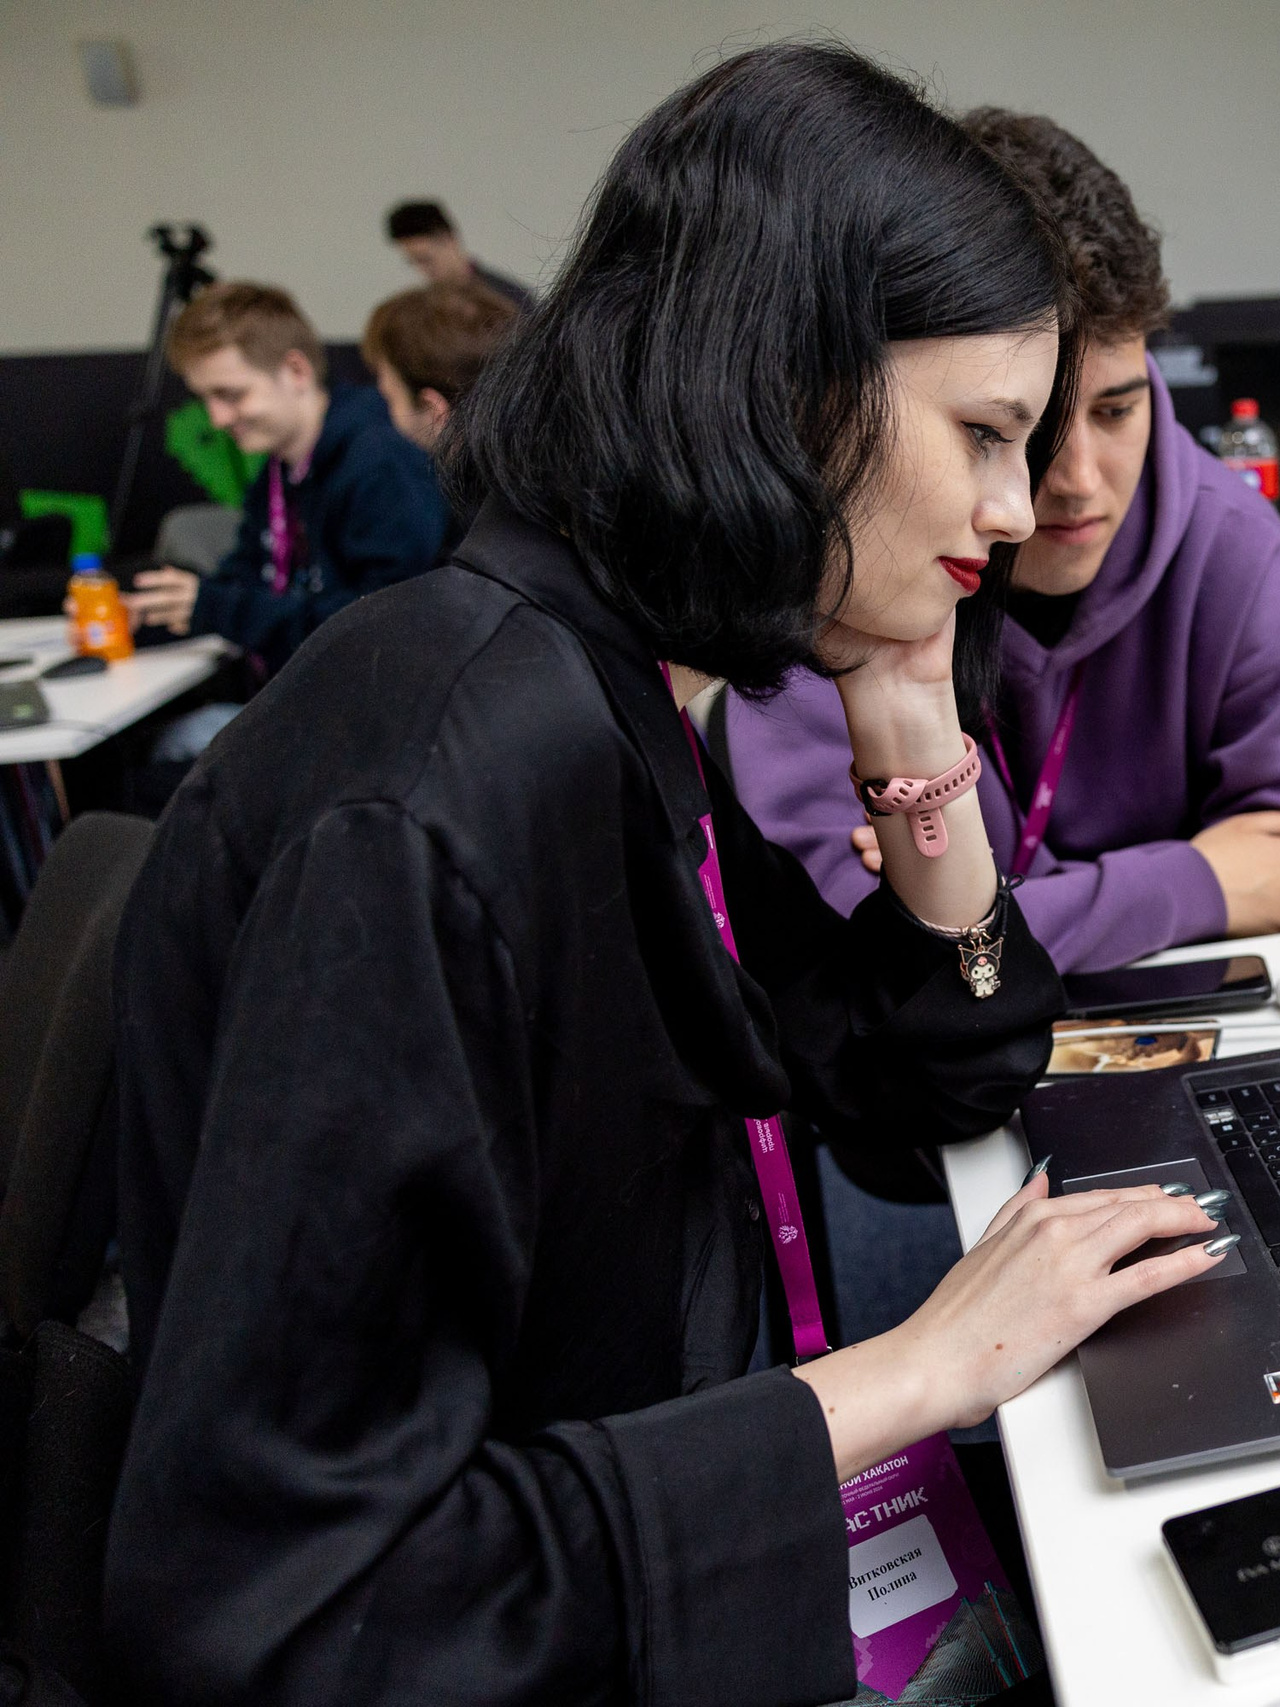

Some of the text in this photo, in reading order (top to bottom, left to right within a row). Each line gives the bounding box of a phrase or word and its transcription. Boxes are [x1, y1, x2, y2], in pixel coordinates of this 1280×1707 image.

[862, 1455, 909, 1481] ХАКАТОН
[848, 1547, 922, 1590] Витковская
[868, 1571, 918, 1602] Полина
